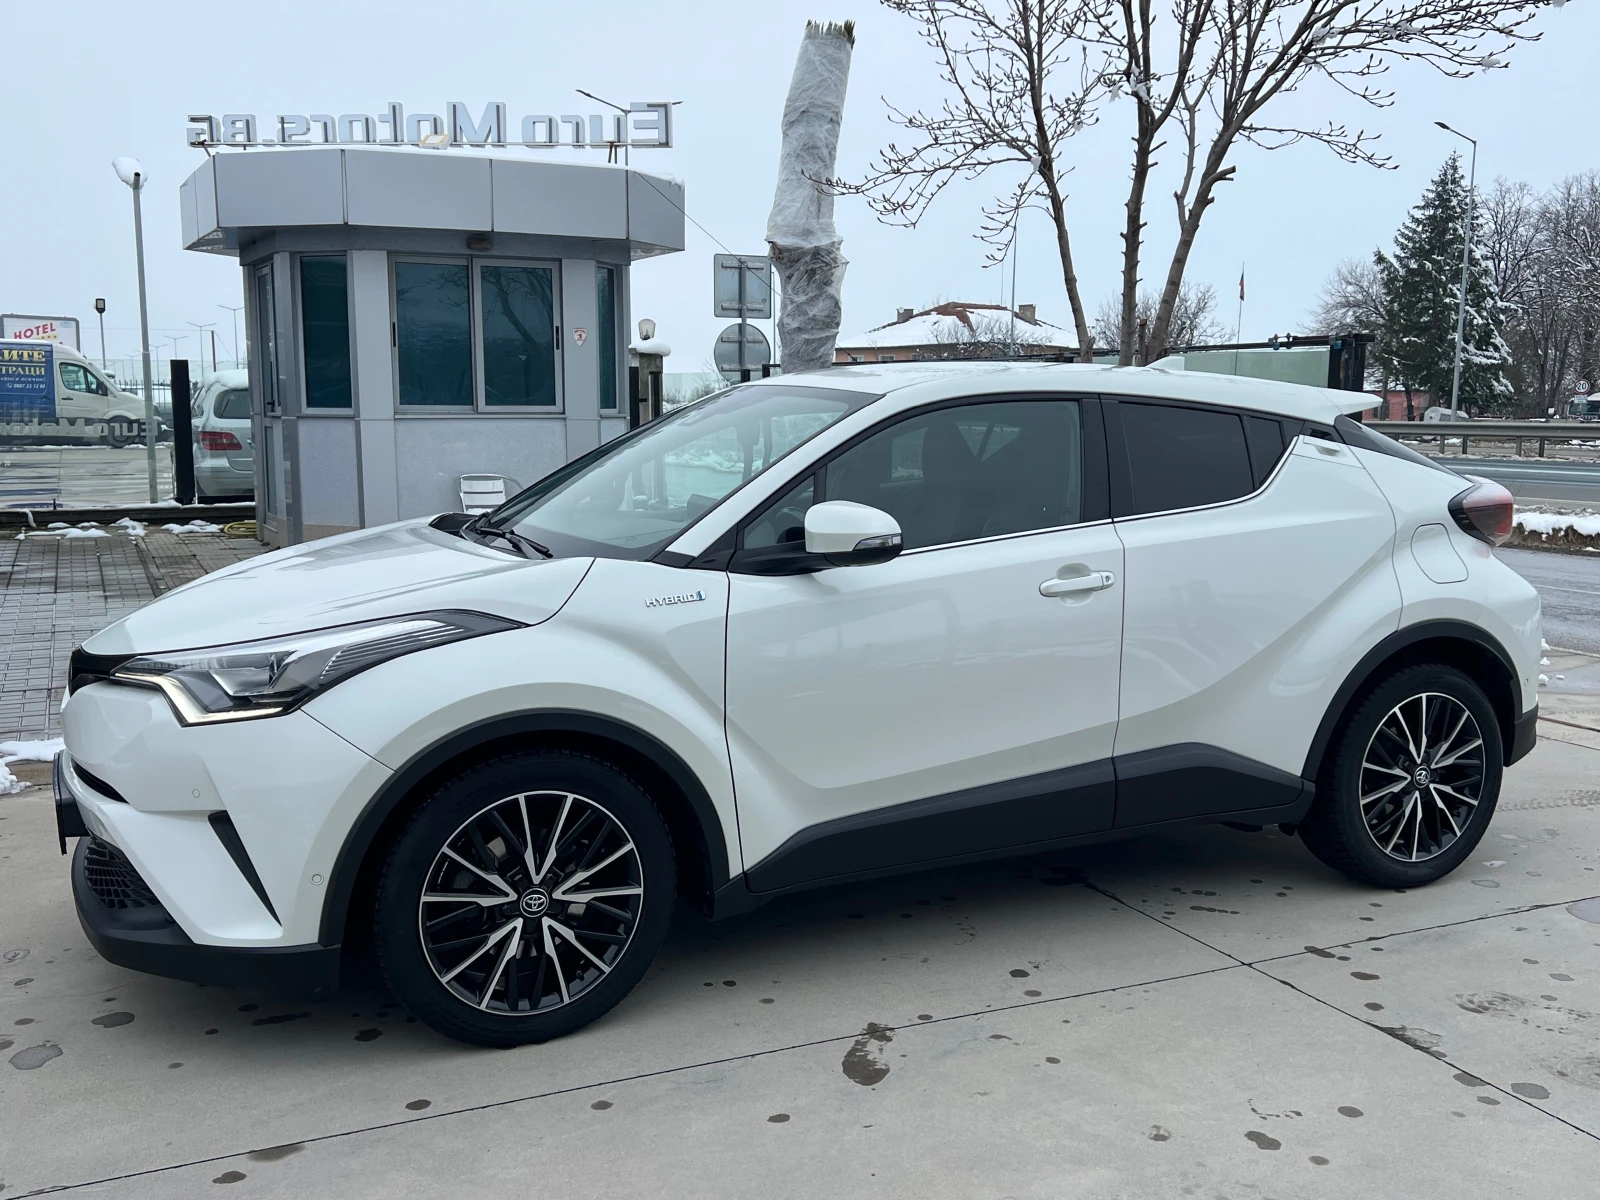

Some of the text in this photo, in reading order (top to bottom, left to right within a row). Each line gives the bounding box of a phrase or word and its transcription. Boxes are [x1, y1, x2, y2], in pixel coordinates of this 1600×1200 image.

[14, 322, 56, 339] HOTEL
[0, 349, 45, 361] ИТЕ
[1577, 382, 1586, 390] 20
[645, 592, 697, 607] HYBRID
